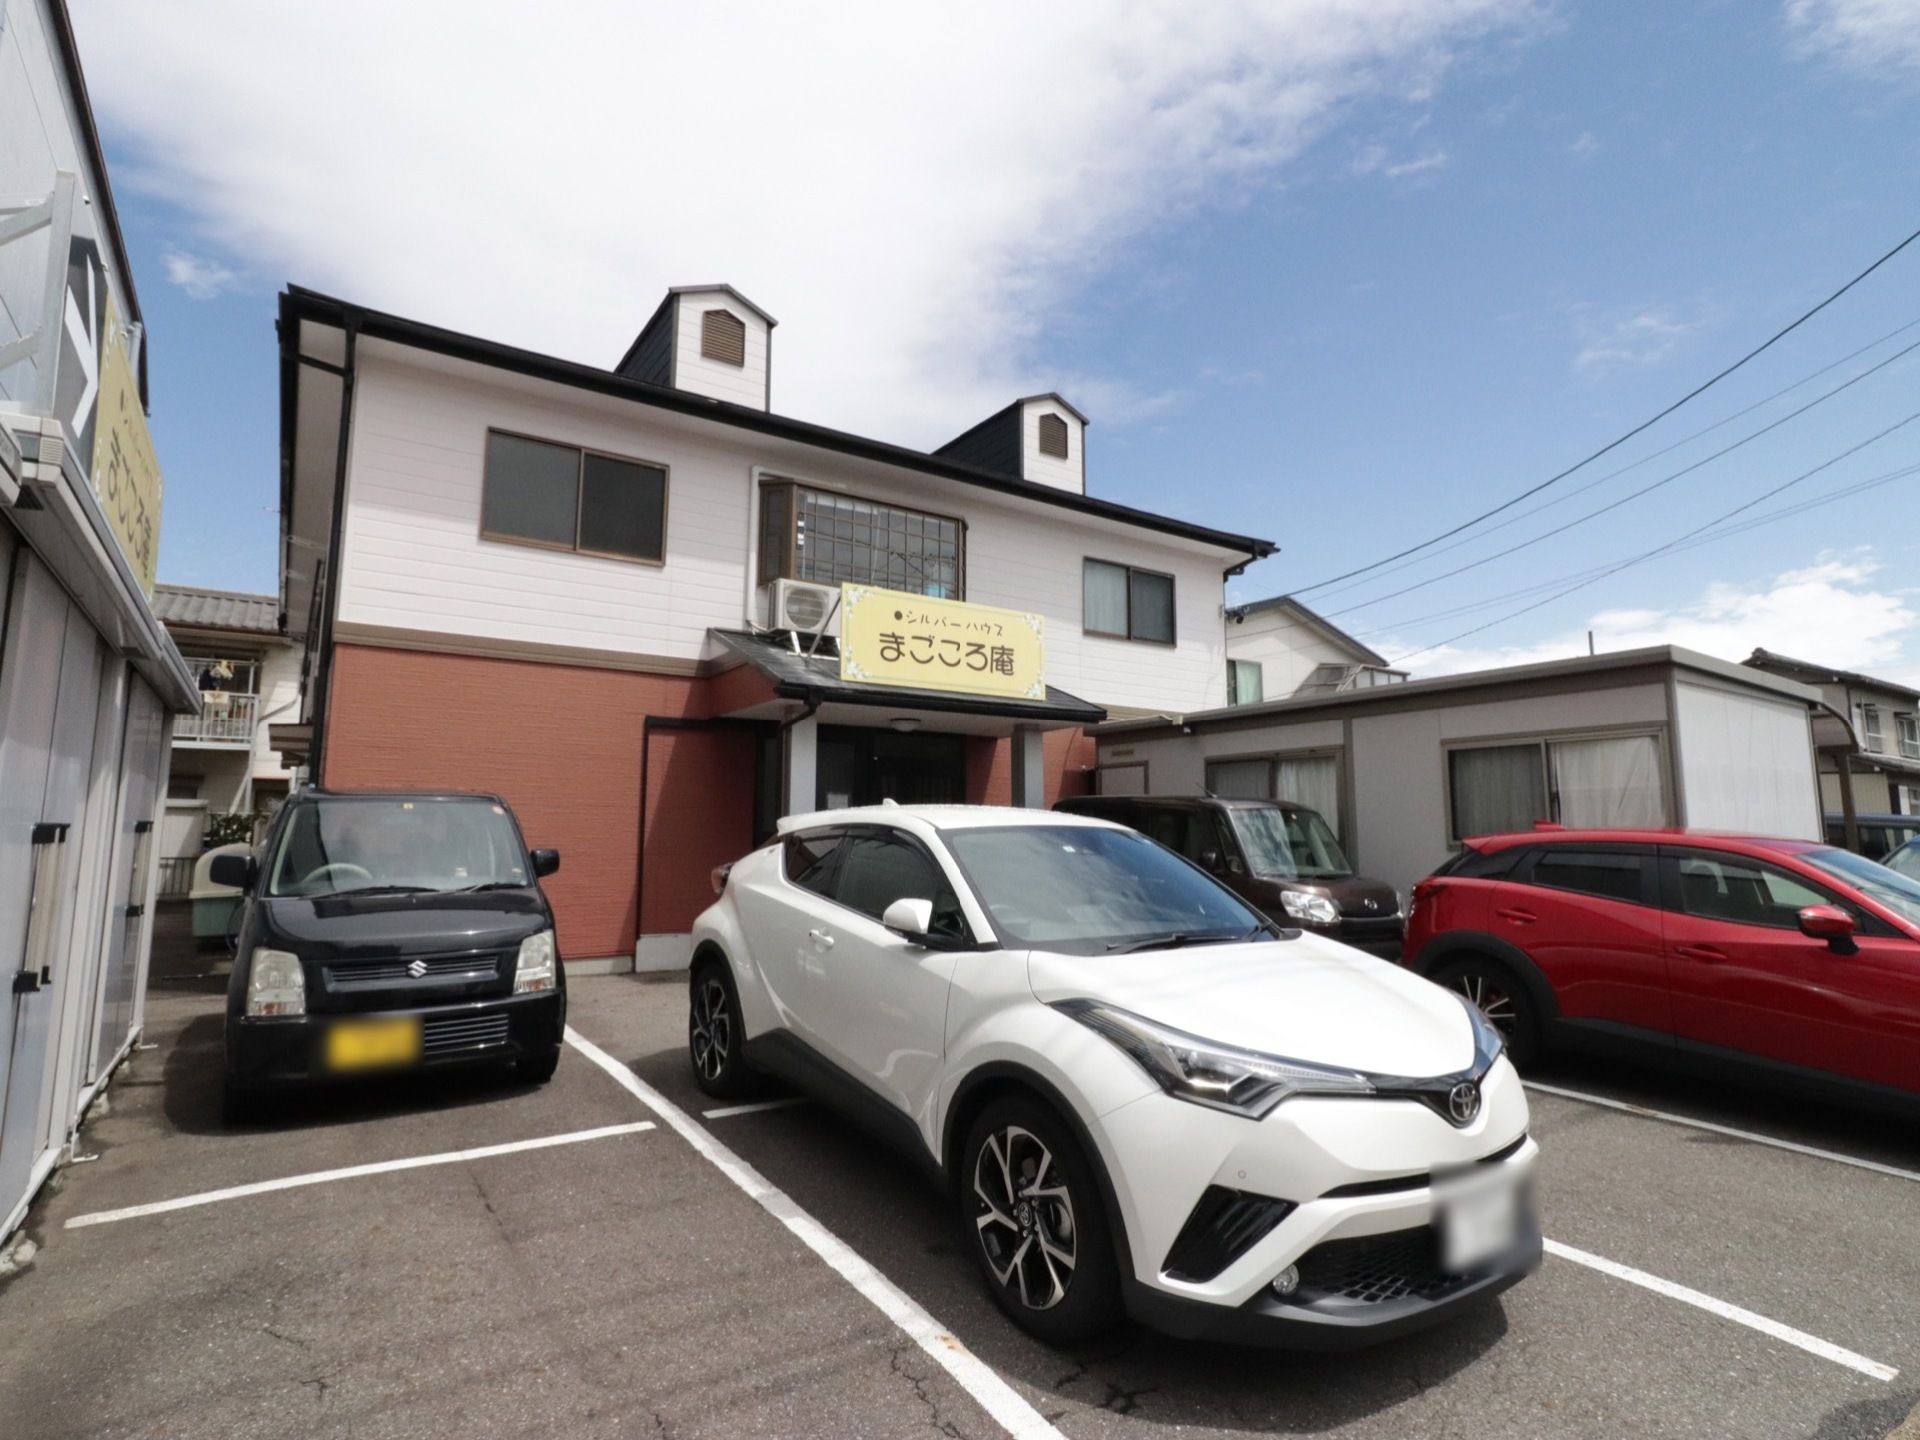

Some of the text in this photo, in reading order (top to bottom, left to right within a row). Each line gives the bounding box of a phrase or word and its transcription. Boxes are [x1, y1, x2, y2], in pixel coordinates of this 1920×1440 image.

[906, 610, 1004, 637] シルバーハウス
[879, 631, 1015, 676] まごころ庵
